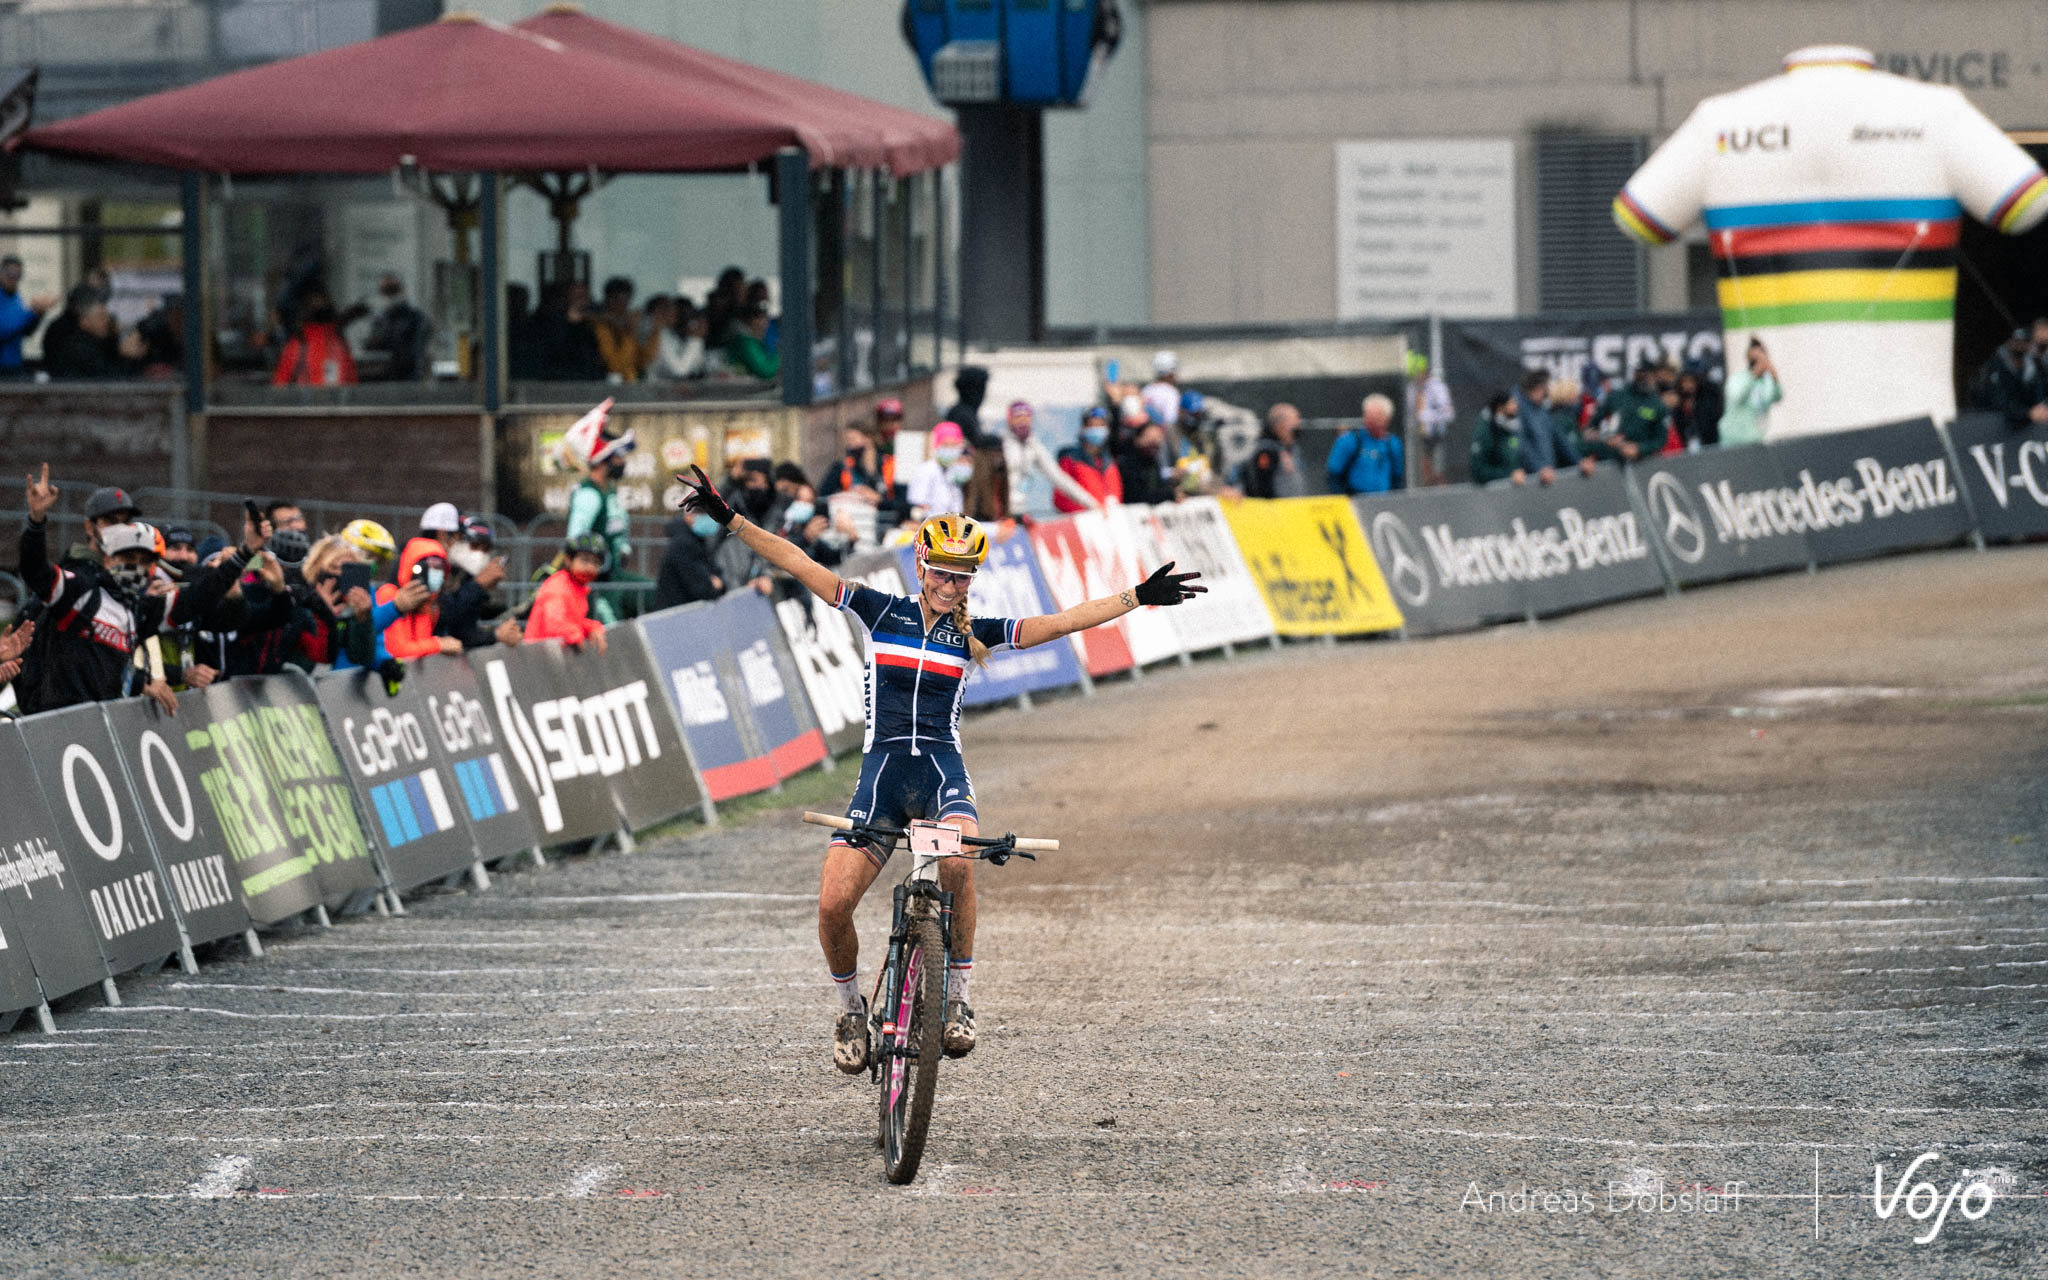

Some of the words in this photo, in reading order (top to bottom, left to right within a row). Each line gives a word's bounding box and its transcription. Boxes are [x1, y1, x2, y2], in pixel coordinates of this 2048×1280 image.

[1875, 51, 2008, 89] RVICE
[1730, 124, 1790, 151] UCI
[1700, 457, 1957, 544] Mercedes-Benz
[1968, 440, 2048, 508] V-C
[1421, 507, 1647, 588] Mercedes-Benz
[937, 631, 961, 645] CIC
[343, 706, 428, 777] GoPro
[429, 690, 493, 753] GoPro
[533, 680, 661, 780] SCOTT
[931, 839, 939, 851] 1
[90, 869, 163, 940] OAKLEY
[170, 854, 233, 912] OAKLEY
